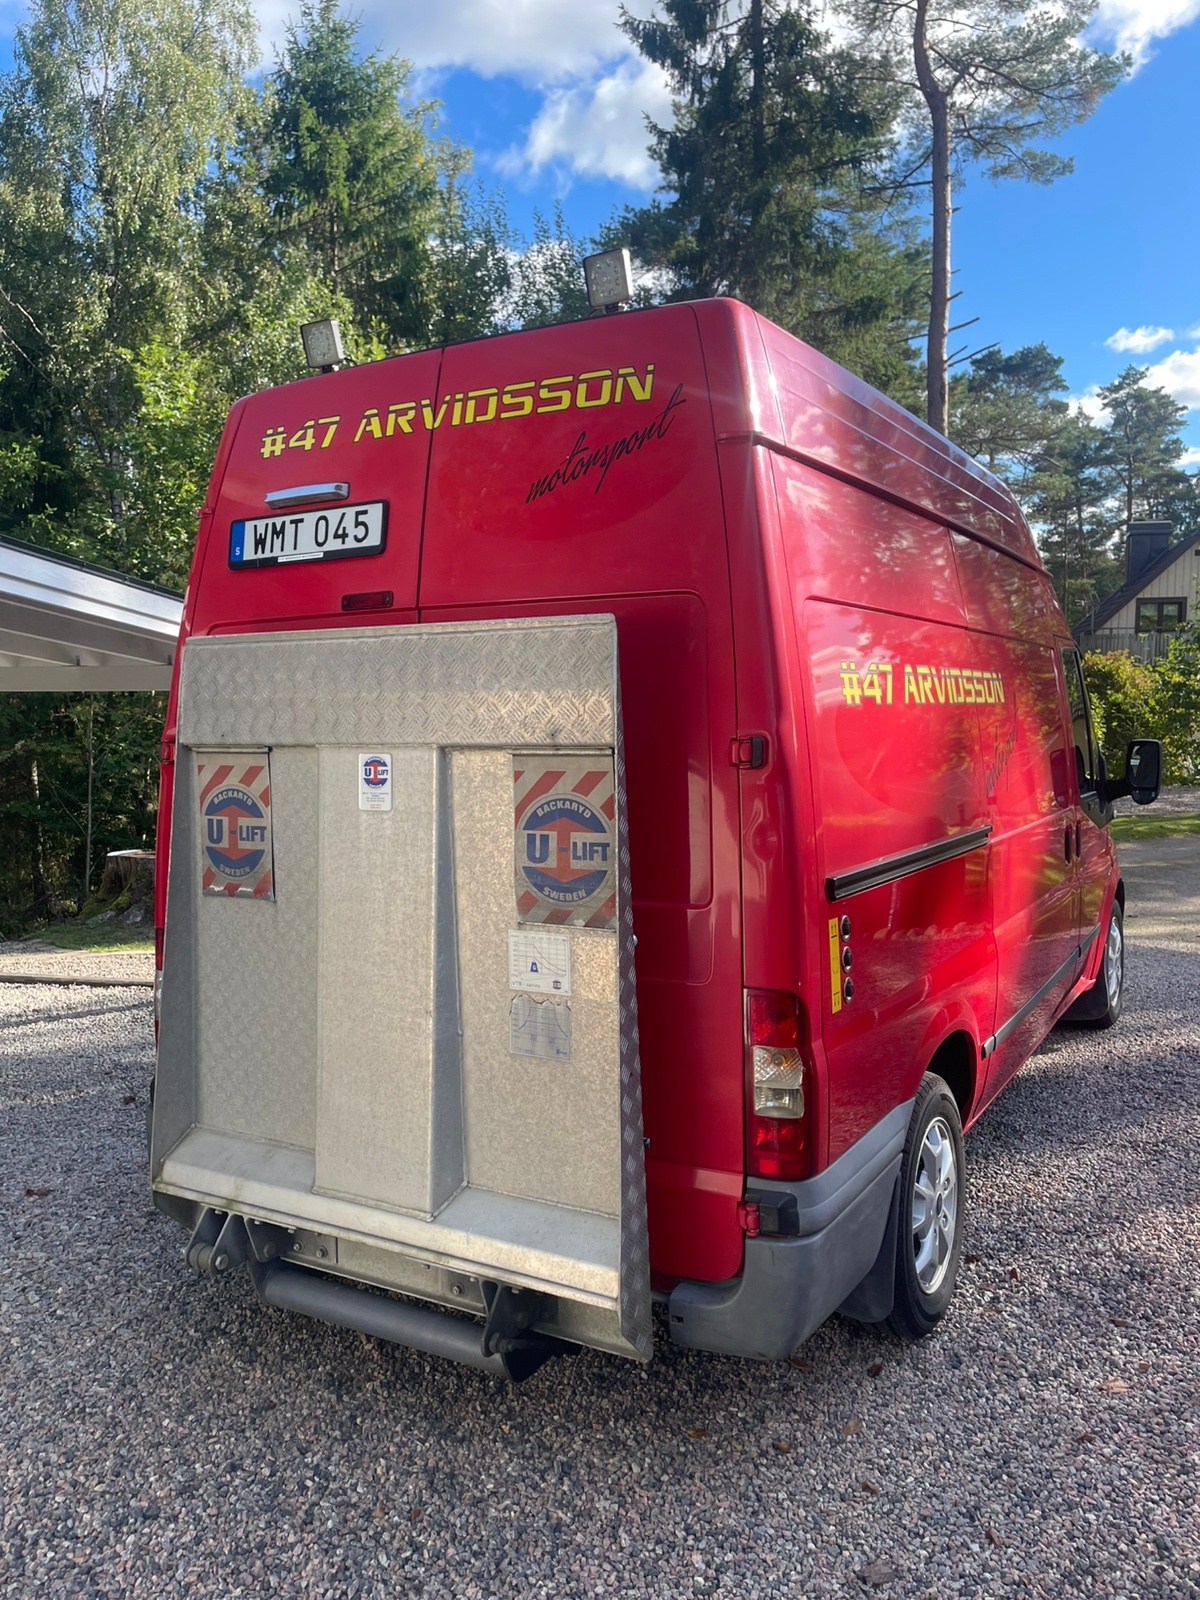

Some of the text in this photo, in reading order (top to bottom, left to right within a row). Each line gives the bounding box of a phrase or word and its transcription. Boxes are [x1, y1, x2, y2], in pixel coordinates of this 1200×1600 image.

[260, 363, 656, 459] #47 ARVIDSSON
[525, 383, 687, 503] motorsport
[253, 509, 369, 555] WMT 045
[234, 547, 241, 556] S
[840, 661, 1006, 706] #47 ARVIDSSON
[213, 789, 253, 806] BACKARYD
[536, 800, 592, 819] BACKARYD
[219, 863, 251, 877] SWEDEN
[542, 886, 587, 901] SWEDEN
